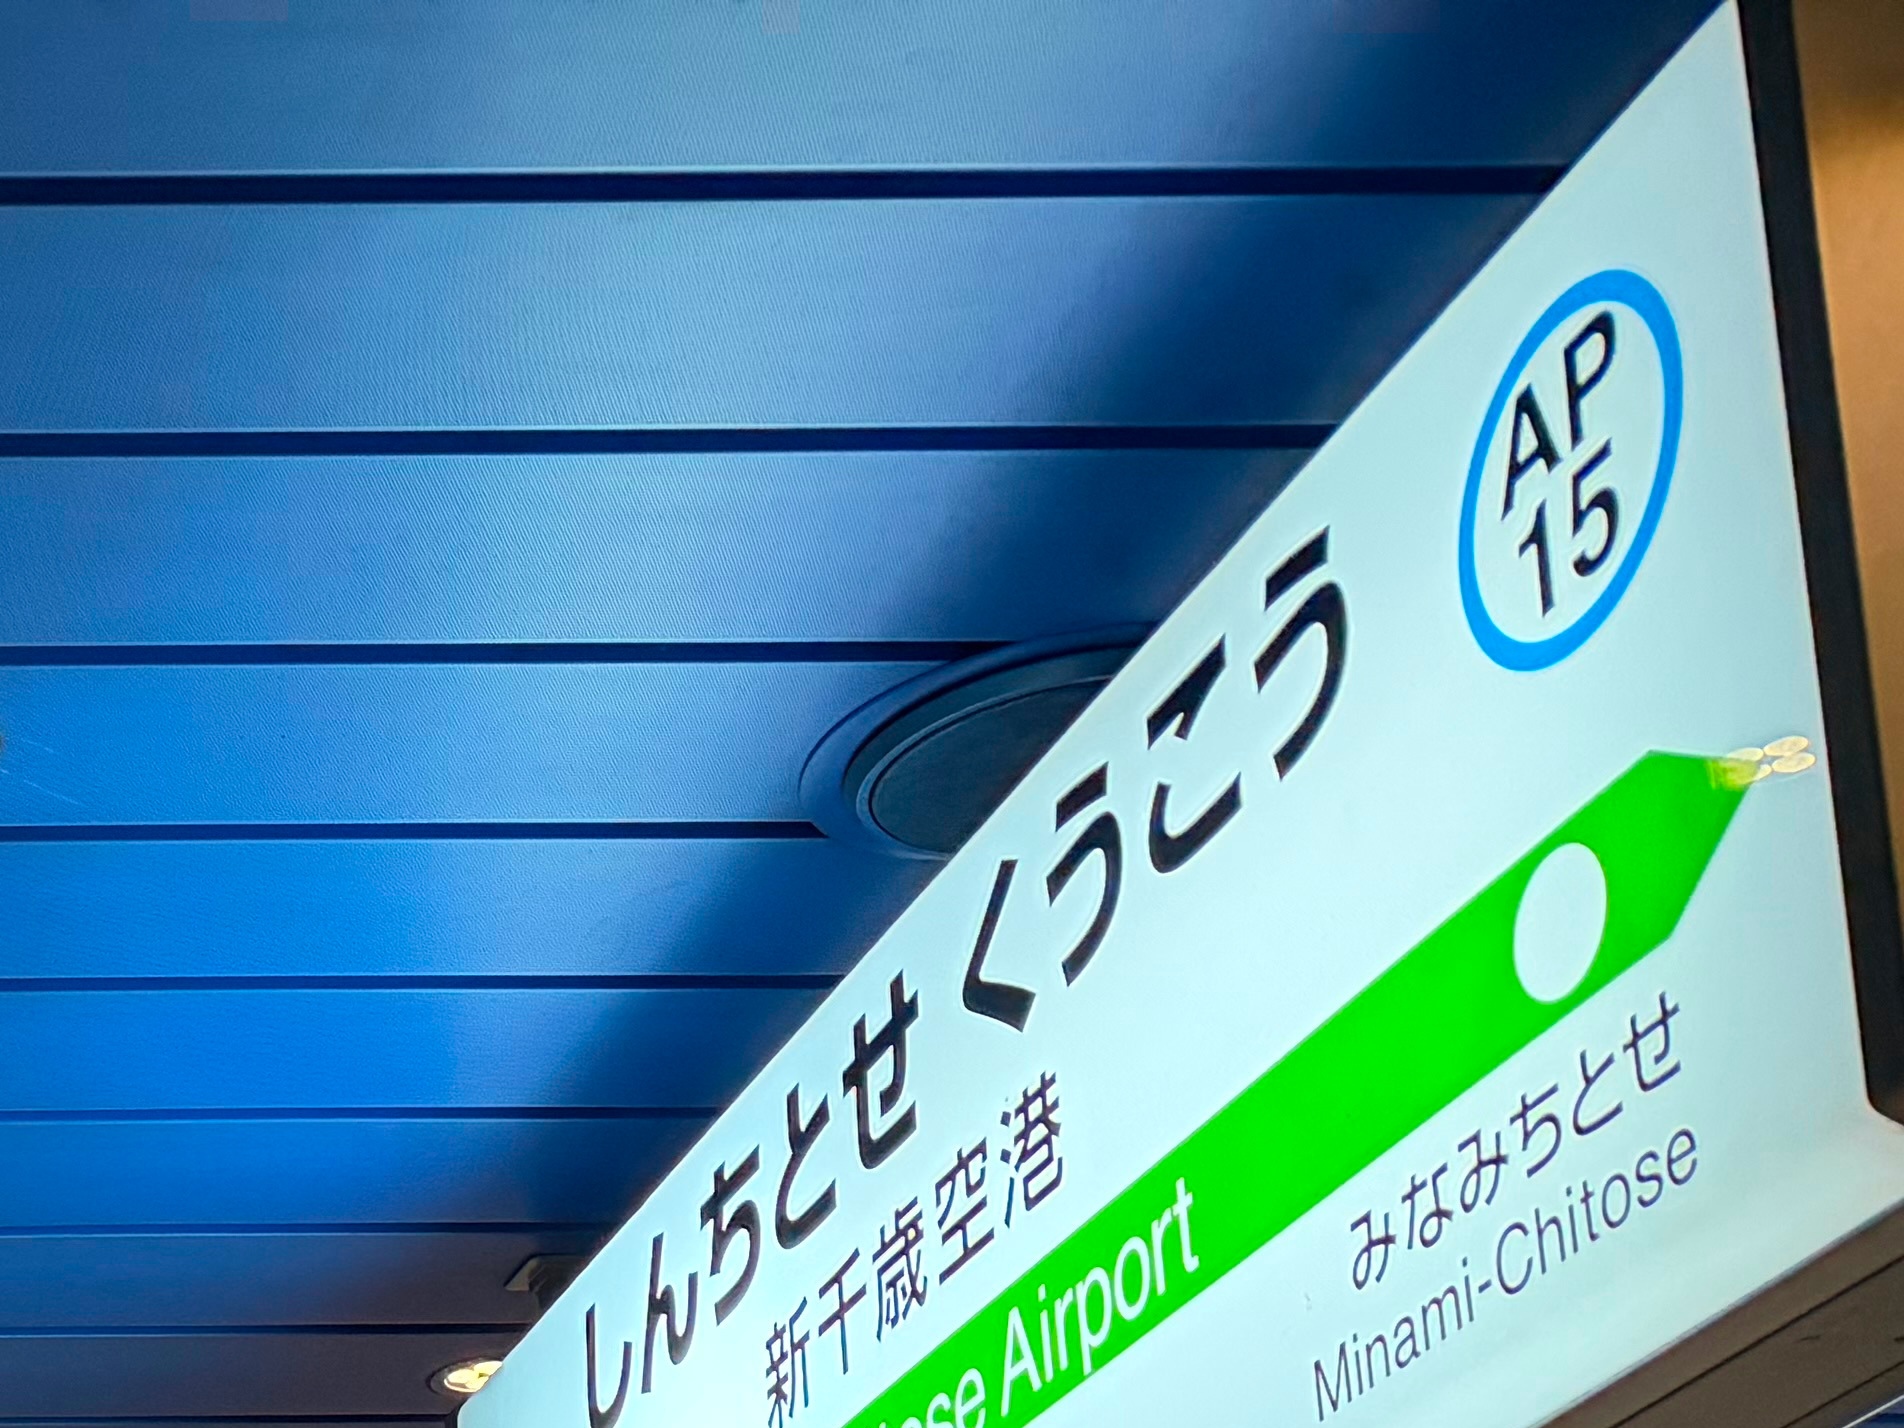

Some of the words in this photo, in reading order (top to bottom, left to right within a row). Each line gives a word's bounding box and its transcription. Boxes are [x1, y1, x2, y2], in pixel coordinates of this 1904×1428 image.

[1501, 310, 1616, 521] AP
[1518, 437, 1619, 618] 15
[766, 1071, 1063, 1428] 新千歳空港
[1350, 991, 1681, 1290] みなみちとせ
[1001, 1177, 1200, 1417] Airport
[1314, 1128, 1698, 1422] Minami-Chitose
